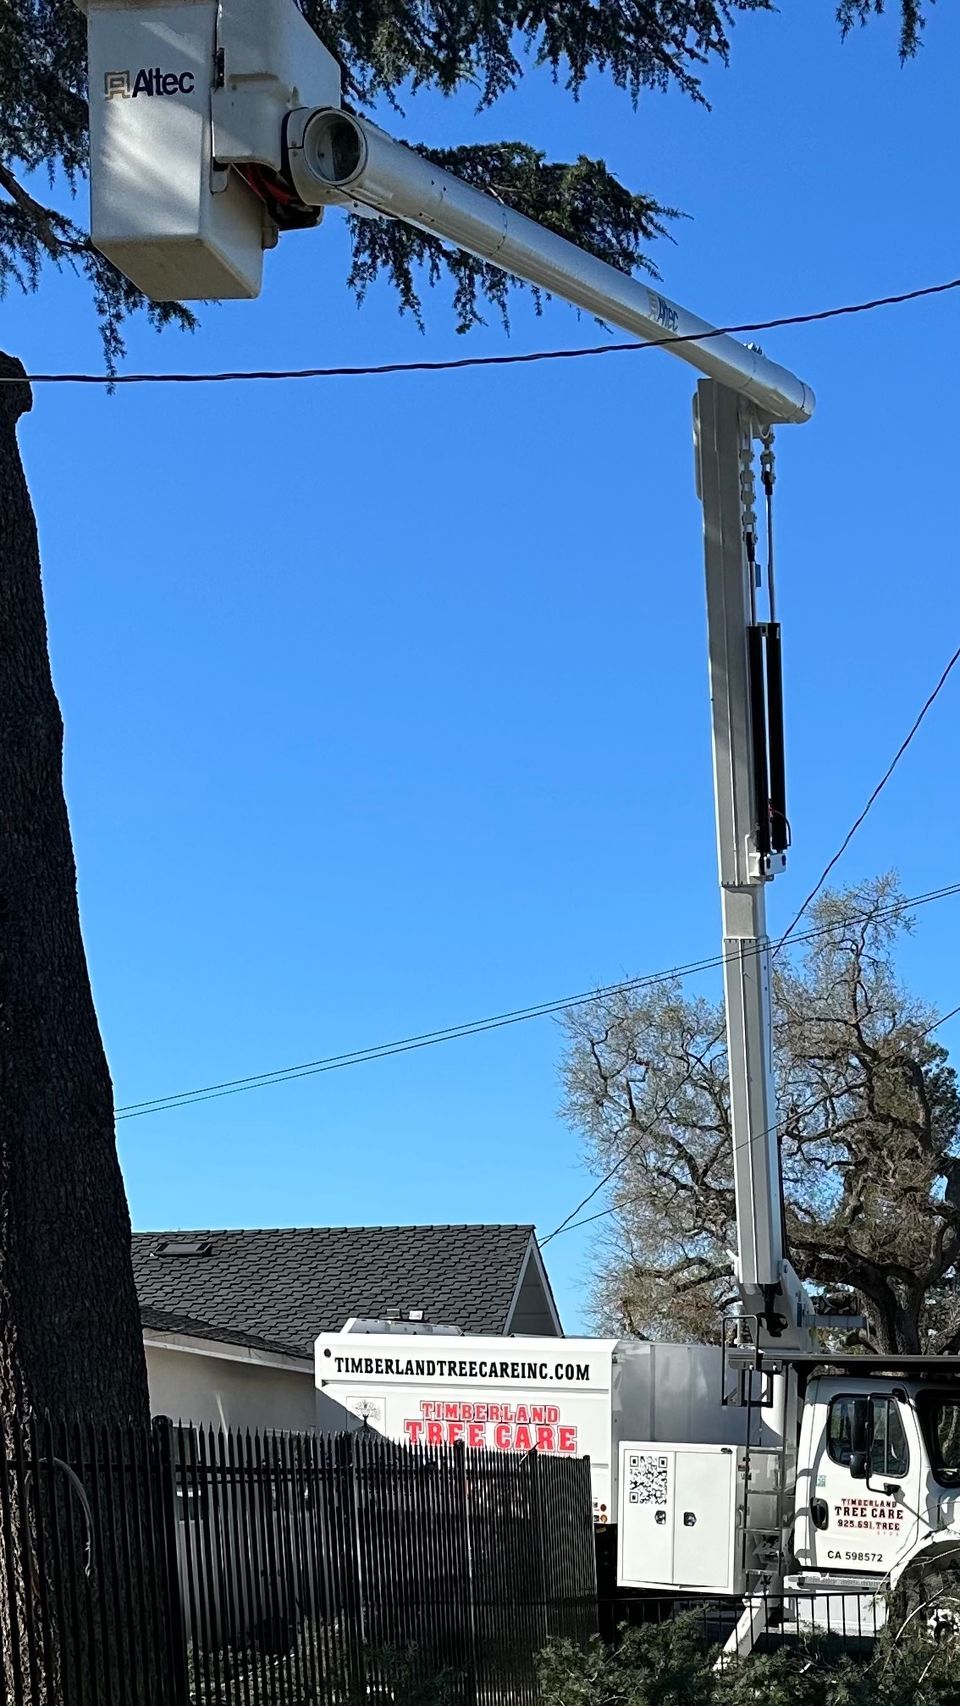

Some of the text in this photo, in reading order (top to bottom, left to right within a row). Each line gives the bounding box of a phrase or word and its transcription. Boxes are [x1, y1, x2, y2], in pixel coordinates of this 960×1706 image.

[131, 68, 195, 98] Altec
[334, 1357, 590, 1381] TIMBERLANDTREECAREINC.COM
[420, 1400, 561, 1424] TIMBERLAND
[404, 1419, 578, 1453] TREE CARE
[834, 1506, 904, 1519] TREE CARE
[827, 1550, 883, 1562] CA 598572
